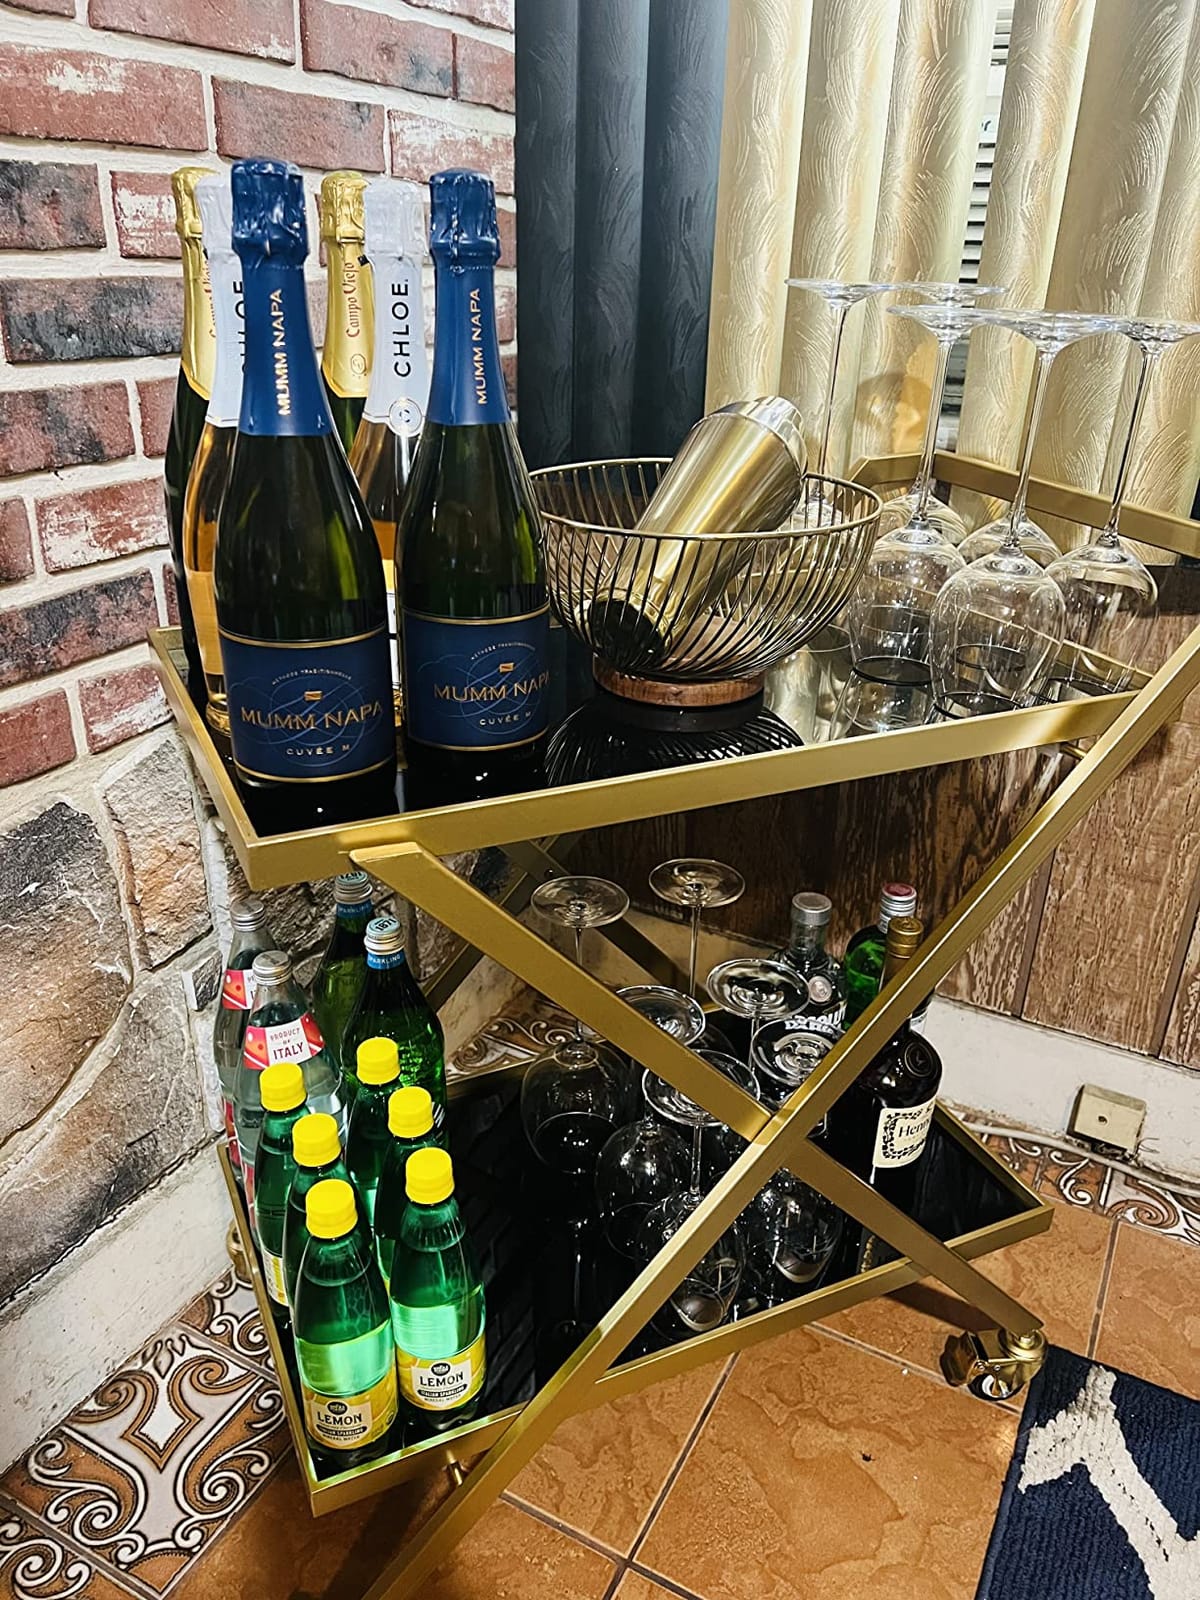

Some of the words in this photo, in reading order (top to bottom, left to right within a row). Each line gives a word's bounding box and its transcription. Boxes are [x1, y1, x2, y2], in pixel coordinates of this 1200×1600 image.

[341, 261, 360, 295] Viejo
[269, 288, 286, 347] NAPA
[346, 298, 362, 337] Campo
[391, 282, 411, 378] CHLOE
[470, 288, 483, 342] NAPA
[273, 352, 292, 416] MUMM
[473, 346, 488, 405] MUMM
[433, 683, 508, 703] MUMM
[241, 705, 317, 731] MUMM
[323, 700, 384, 729] NAPA
[286, 744, 335, 757] CUVÉE
[374, 918, 397, 931] 1871
[269, 1026, 301, 1042] PRODUCT
[272, 1041, 305, 1061] ITALY
[420, 1371, 464, 1387] LEMON
[317, 1411, 363, 1426] LEMON
